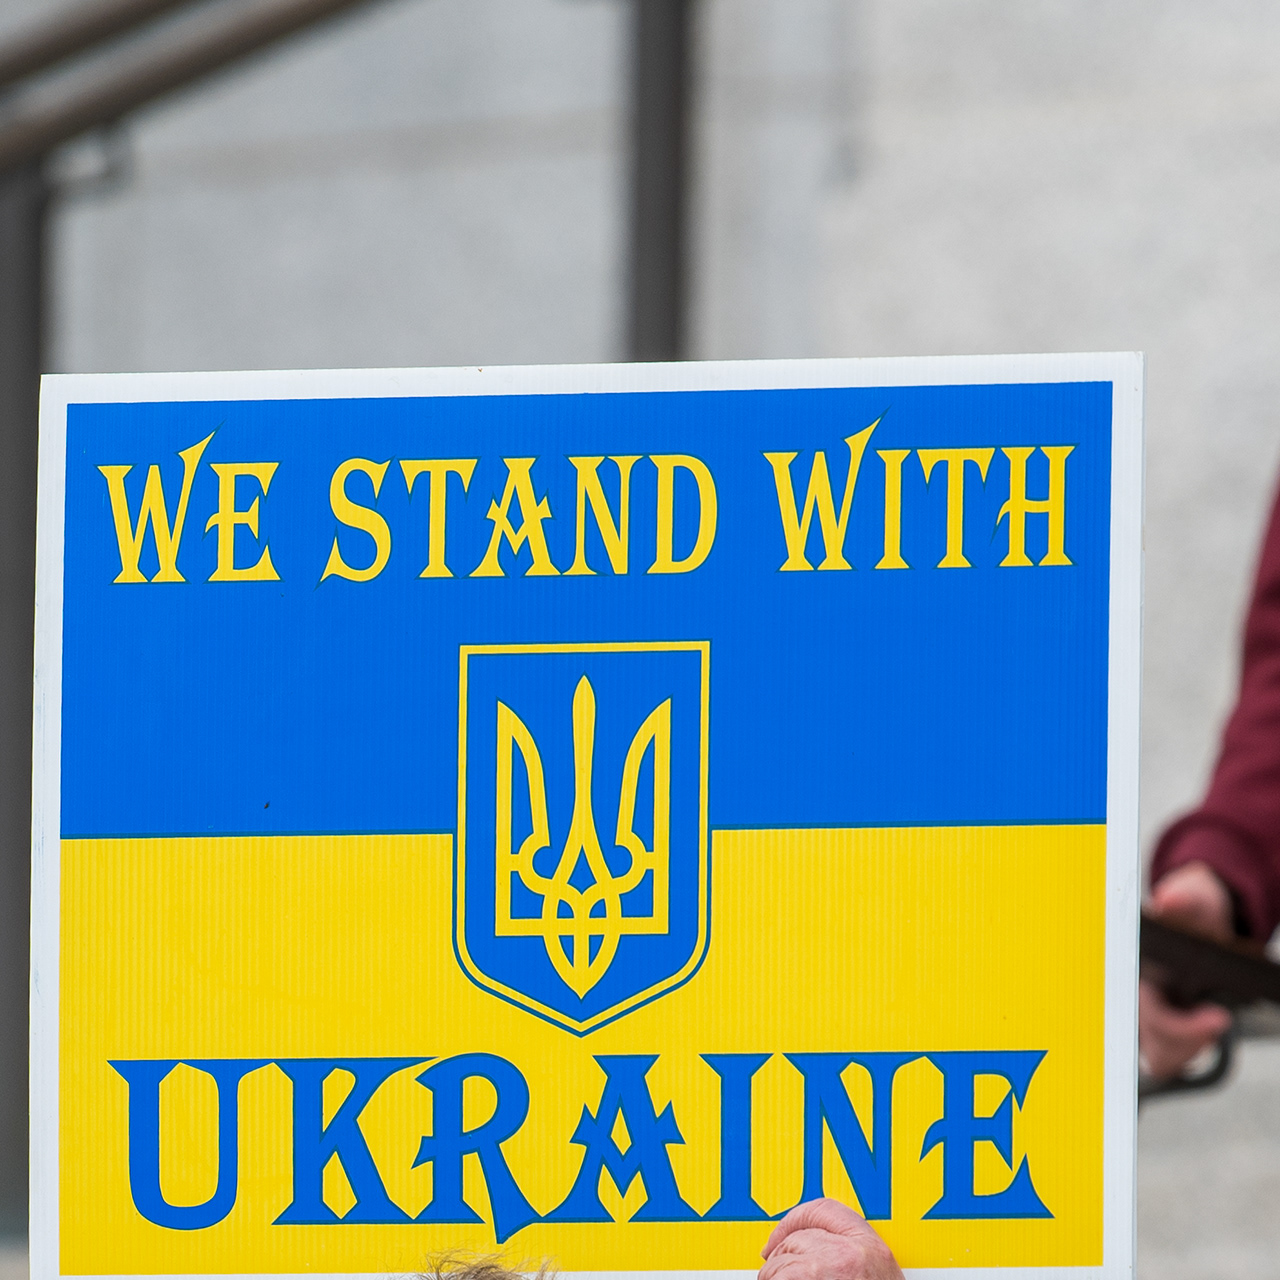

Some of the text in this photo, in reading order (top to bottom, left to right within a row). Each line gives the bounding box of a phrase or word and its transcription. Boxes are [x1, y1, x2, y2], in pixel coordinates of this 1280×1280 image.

[97, 417, 1075, 584] WE STAND WITH
[106, 1050, 1054, 1245] UKRAINE
